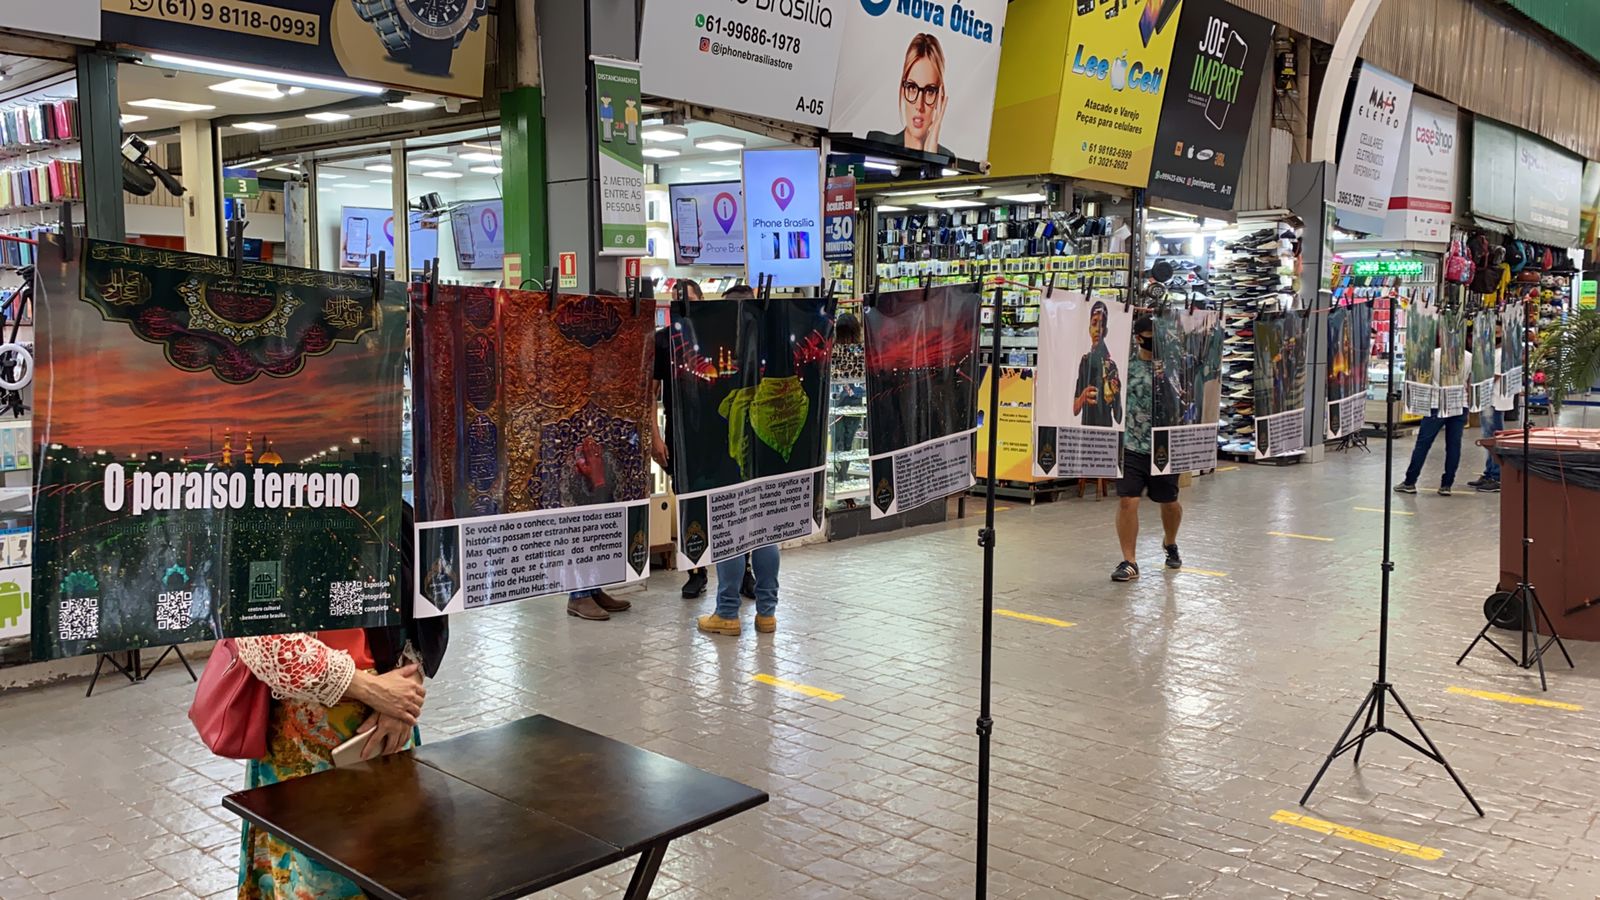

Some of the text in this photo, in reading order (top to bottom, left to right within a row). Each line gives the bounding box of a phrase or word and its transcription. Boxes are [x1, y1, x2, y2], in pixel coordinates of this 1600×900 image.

[158, 0, 316, 38] (61) 9 8118-0993
[896, 0, 993, 44] Nova Ótica
[706, 15, 801, 54] 61-99686-1978
[1200, 16, 1230, 58] JOE
[711, 42, 793, 70] @iphonebrasiliastore
[598, 72, 638, 84] DISTANCIAMENTO
[1072, 44, 1164, 95] Lee Cell
[1190, 54, 1244, 104] IMPORT
[796, 96, 824, 116] A-05
[1084, 98, 1140, 122] Atacado e Varejo
[1359, 105, 1398, 128] ELETRO
[1076, 111, 1142, 134] Peças para celulares
[1088, 143, 1096, 152] 61
[1088, 155, 1096, 165] 61
[238, 180, 248, 192] 3
[604, 176, 642, 187] 2 METROS
[604, 188, 642, 200] ENTRE AS
[606, 202, 640, 212] PESSOAS
[752, 218, 782, 228] iPhone
[832, 216, 852, 240] 30
[826, 240, 853, 252] MINUTOS
[104, 462, 360, 516] O paraíso terreno
[765, 482, 776, 490] isso
[778, 478, 798, 489] significa
[712, 502, 734, 512] também
[759, 490, 782, 500] lutando
[786, 486, 802, 495] contra
[760, 500, 777, 508] somos
[780, 495, 800, 504] inimigos
[466, 527, 476, 536] Se
[478, 524, 497, 534] você
[500, 522, 514, 531] não
[524, 518, 556, 528] conhece,
[559, 516, 580, 524] talvez
[582, 513, 602, 522] todas
[728, 516, 747, 527] Também
[766, 506, 788, 516] amáveis
[466, 520, 618, 546] histórias possam ser estranhas para você.
[739, 535, 744, 544] ya
[774, 521, 794, 532] significa
[800, 518, 809, 526] que
[466, 550, 482, 558] Mas
[486, 546, 510, 557] quem
[520, 540, 551, 550] conhece
[554, 537, 569, 546] não
[572, 536, 580, 544] se
[582, 531, 622, 542] surpreende
[713, 547, 735, 558] também
[756, 536, 764, 544] ser
[466, 562, 477, 570] ao
[571, 546, 584, 554] dos
[590, 542, 622, 552] enfermos
[512, 566, 526, 576] que
[528, 564, 536, 572] se
[540, 560, 564, 569] curam
[568, 558, 572, 566] a
[576, 556, 593, 564] cada
[363, 580, 390, 590] Exposição
[507, 578, 516, 586] de
[467, 593, 488, 604] Deus
[490, 592, 506, 600] ama
[508, 586, 530, 597] muito
[264, 604, 281, 612] cultural
[364, 605, 389, 614] completa
